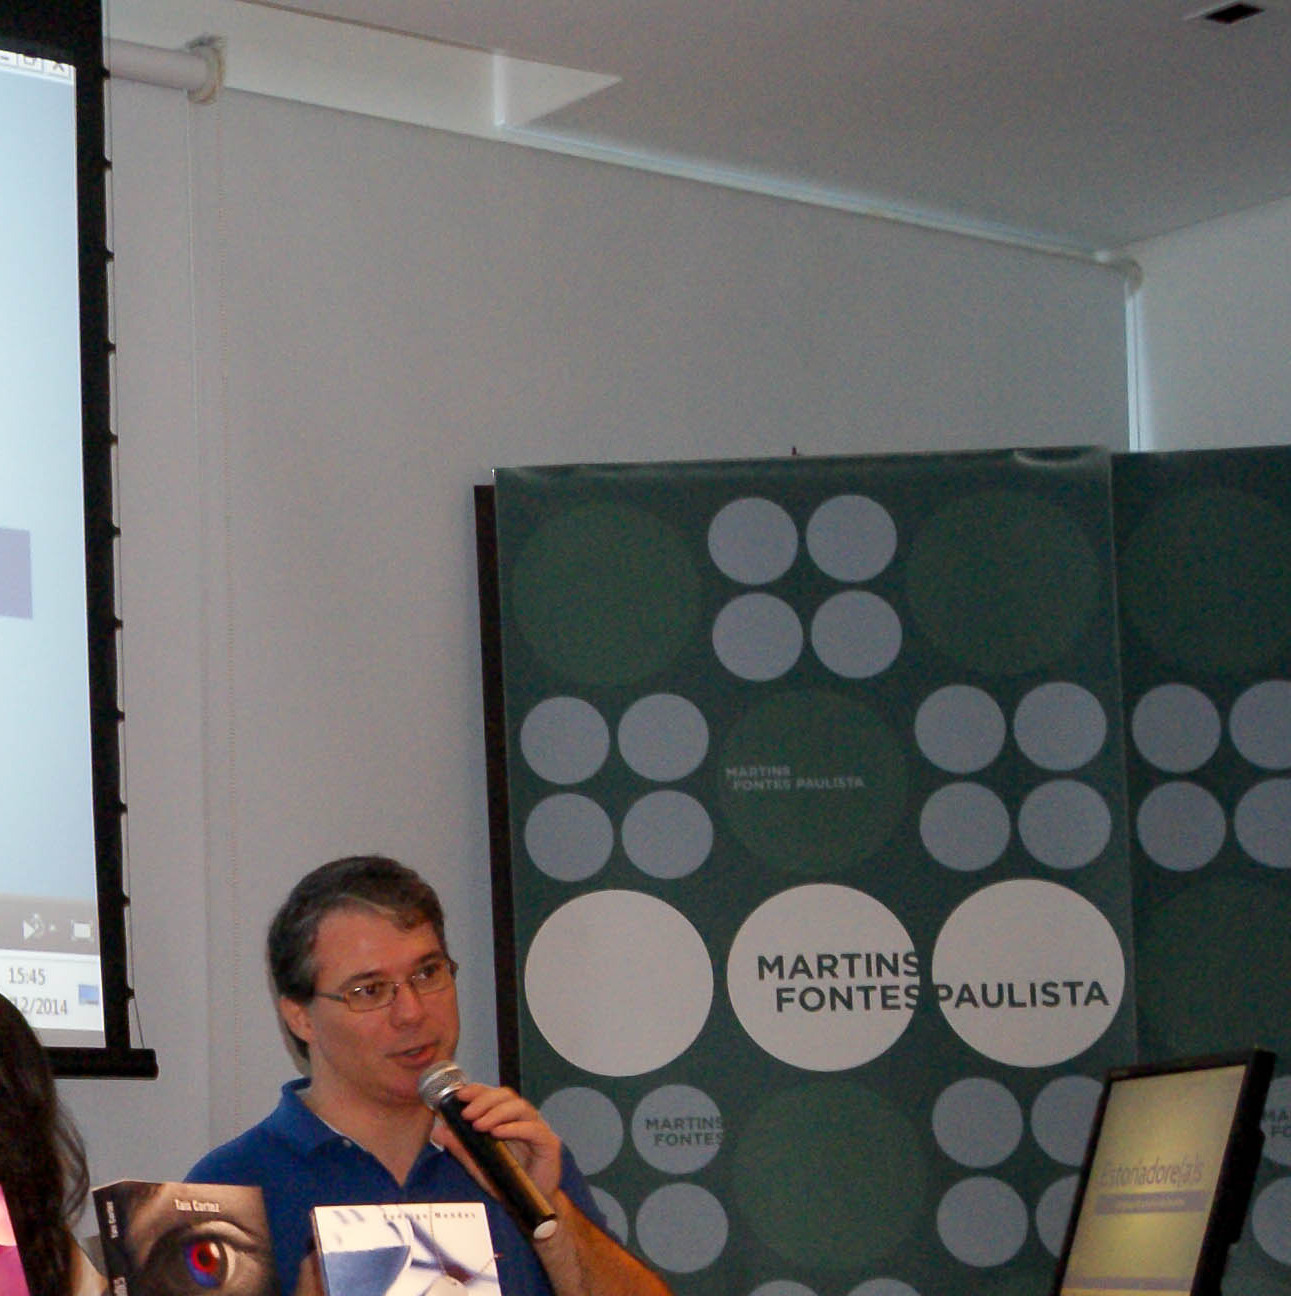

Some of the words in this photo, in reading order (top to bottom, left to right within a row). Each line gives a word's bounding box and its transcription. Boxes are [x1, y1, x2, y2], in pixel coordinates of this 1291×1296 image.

[725, 767, 791, 778] MARTINS
[733, 779, 792, 791] FONTES
[796, 777, 865, 790] PAULISTA
[758, 951, 920, 981] MARTINS
[7, 967, 46, 986] 15:45
[775, 983, 920, 1013] FONTES
[932, 980, 1111, 1009] PAULISTA
